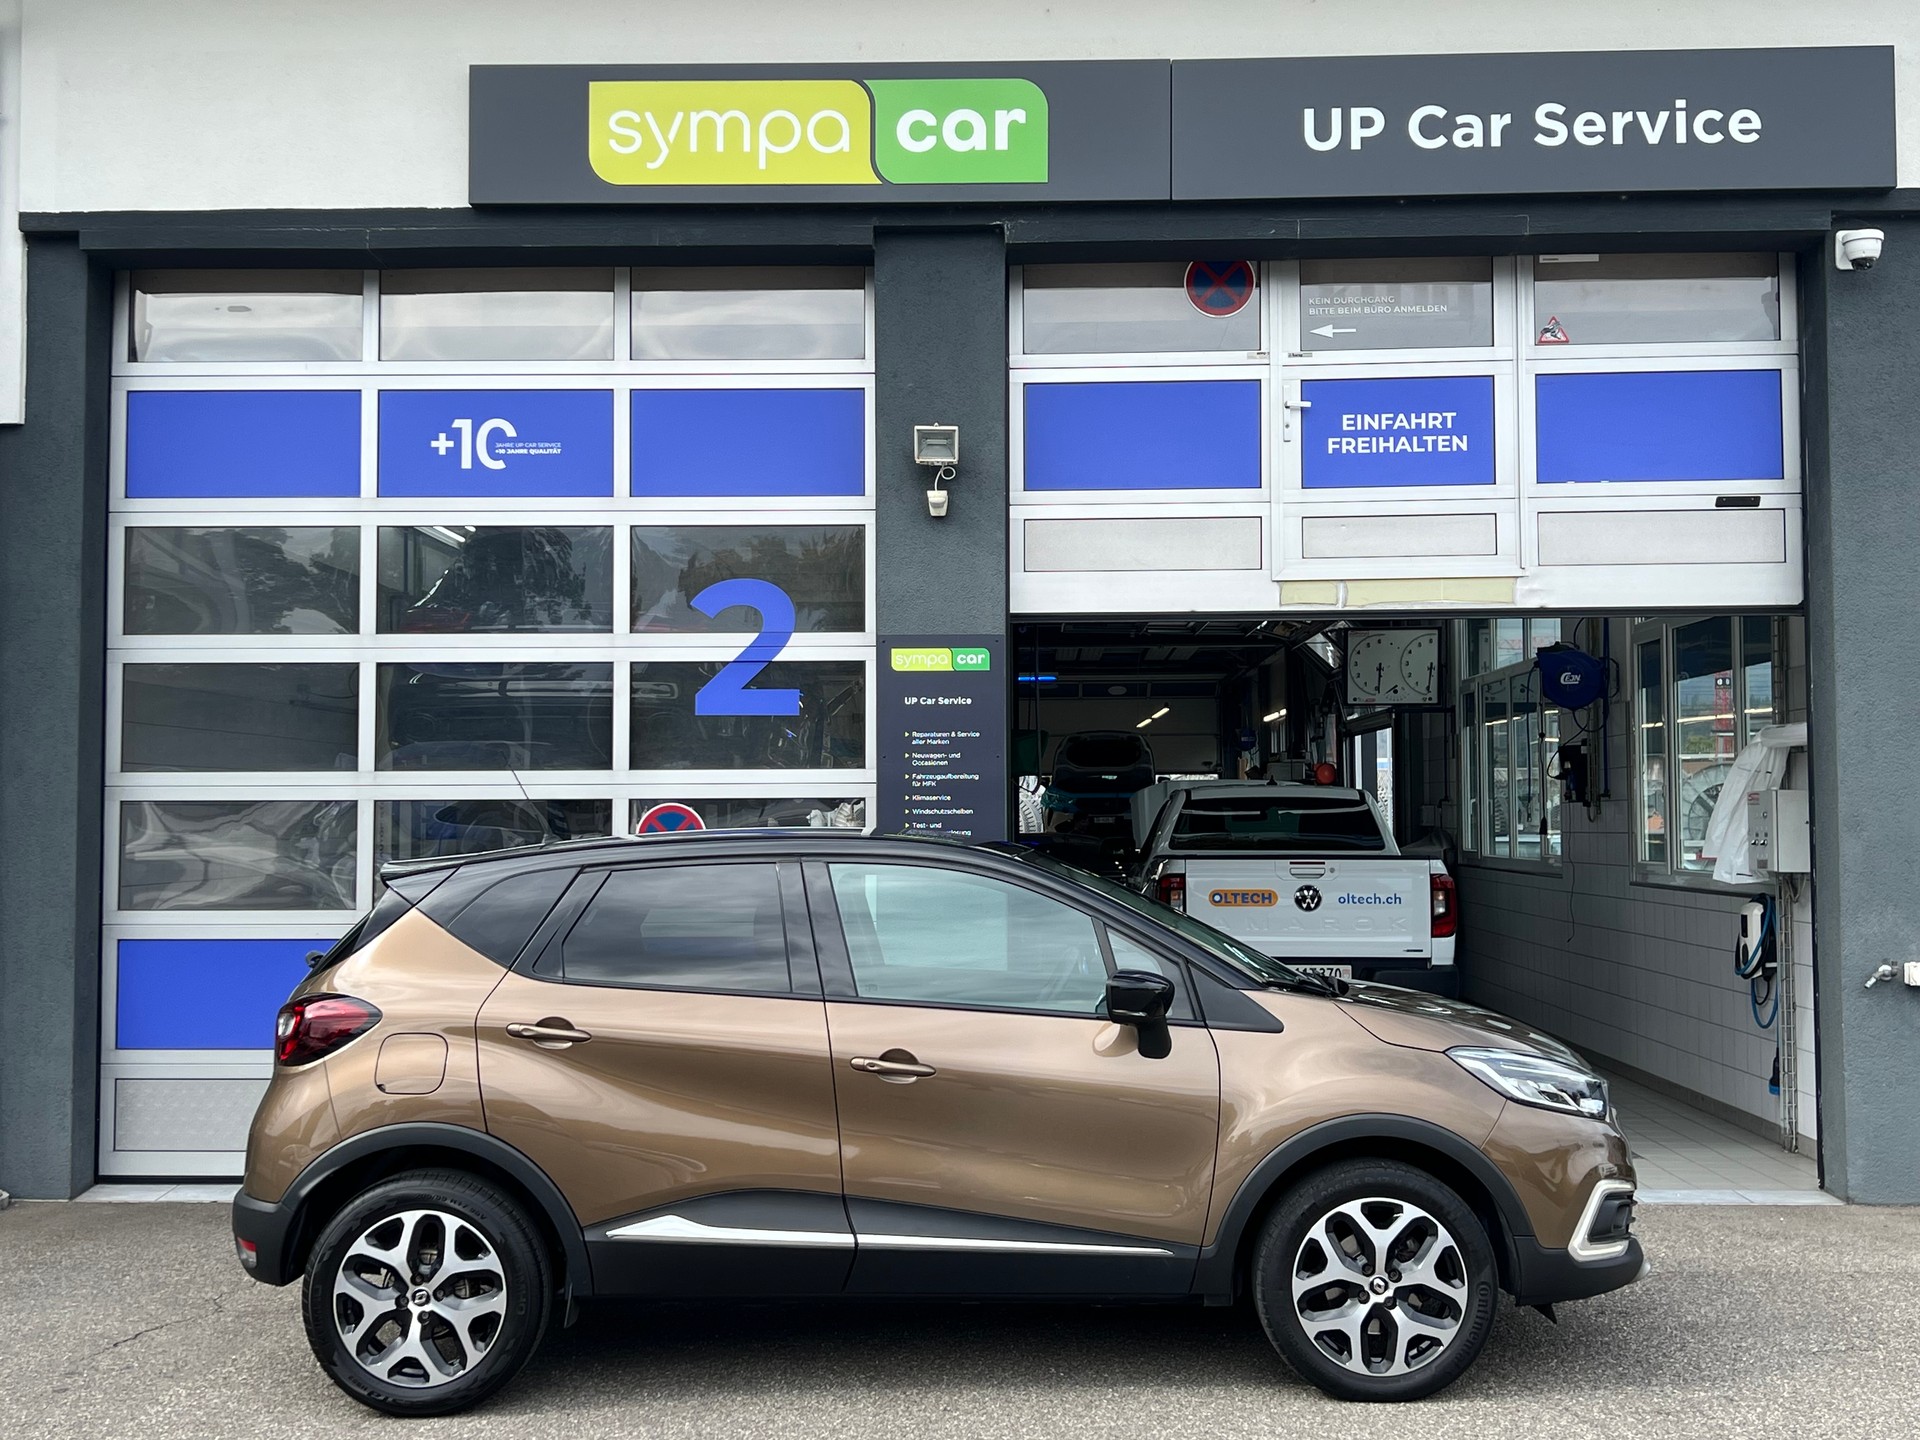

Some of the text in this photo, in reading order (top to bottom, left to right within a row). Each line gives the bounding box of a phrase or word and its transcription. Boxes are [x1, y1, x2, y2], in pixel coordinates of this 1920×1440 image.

[1303, 98, 1762, 152] UP Car Service
[608, 108, 1026, 170] sympa car
[1308, 295, 1395, 305] KEIN DURCHGANG
[1308, 304, 1447, 316] BITTE BEIM BÜRO ANMELDEN
[1342, 412, 1456, 431] EINFAHRT
[1327, 435, 1468, 454] FREIHALTEN
[690, 577, 800, 716] 2
[895, 653, 985, 667] sympa car
[938, 697, 972, 705] Service
[1212, 892, 1402, 905] OLTECH oltech.ch
